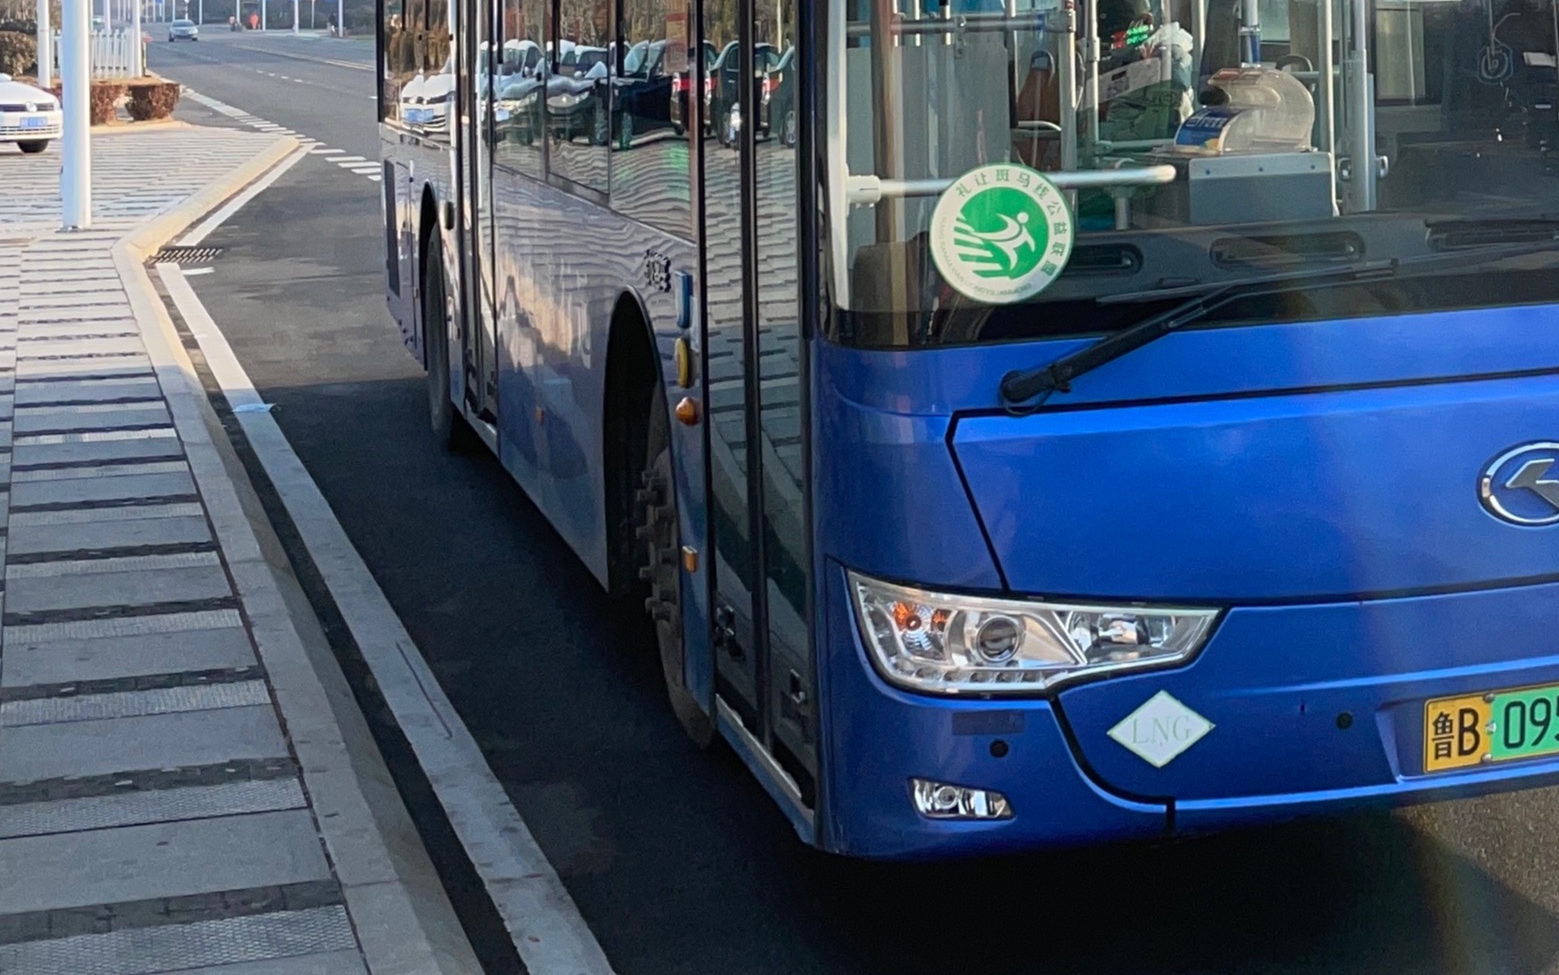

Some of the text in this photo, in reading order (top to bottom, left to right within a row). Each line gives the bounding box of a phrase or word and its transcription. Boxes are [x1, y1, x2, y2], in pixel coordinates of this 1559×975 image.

[955, 169, 1068, 277] 礼让斑马线公益联盟
[1130, 713, 1193, 745] LNG
[1431, 707, 1481, 761] 鲁B
